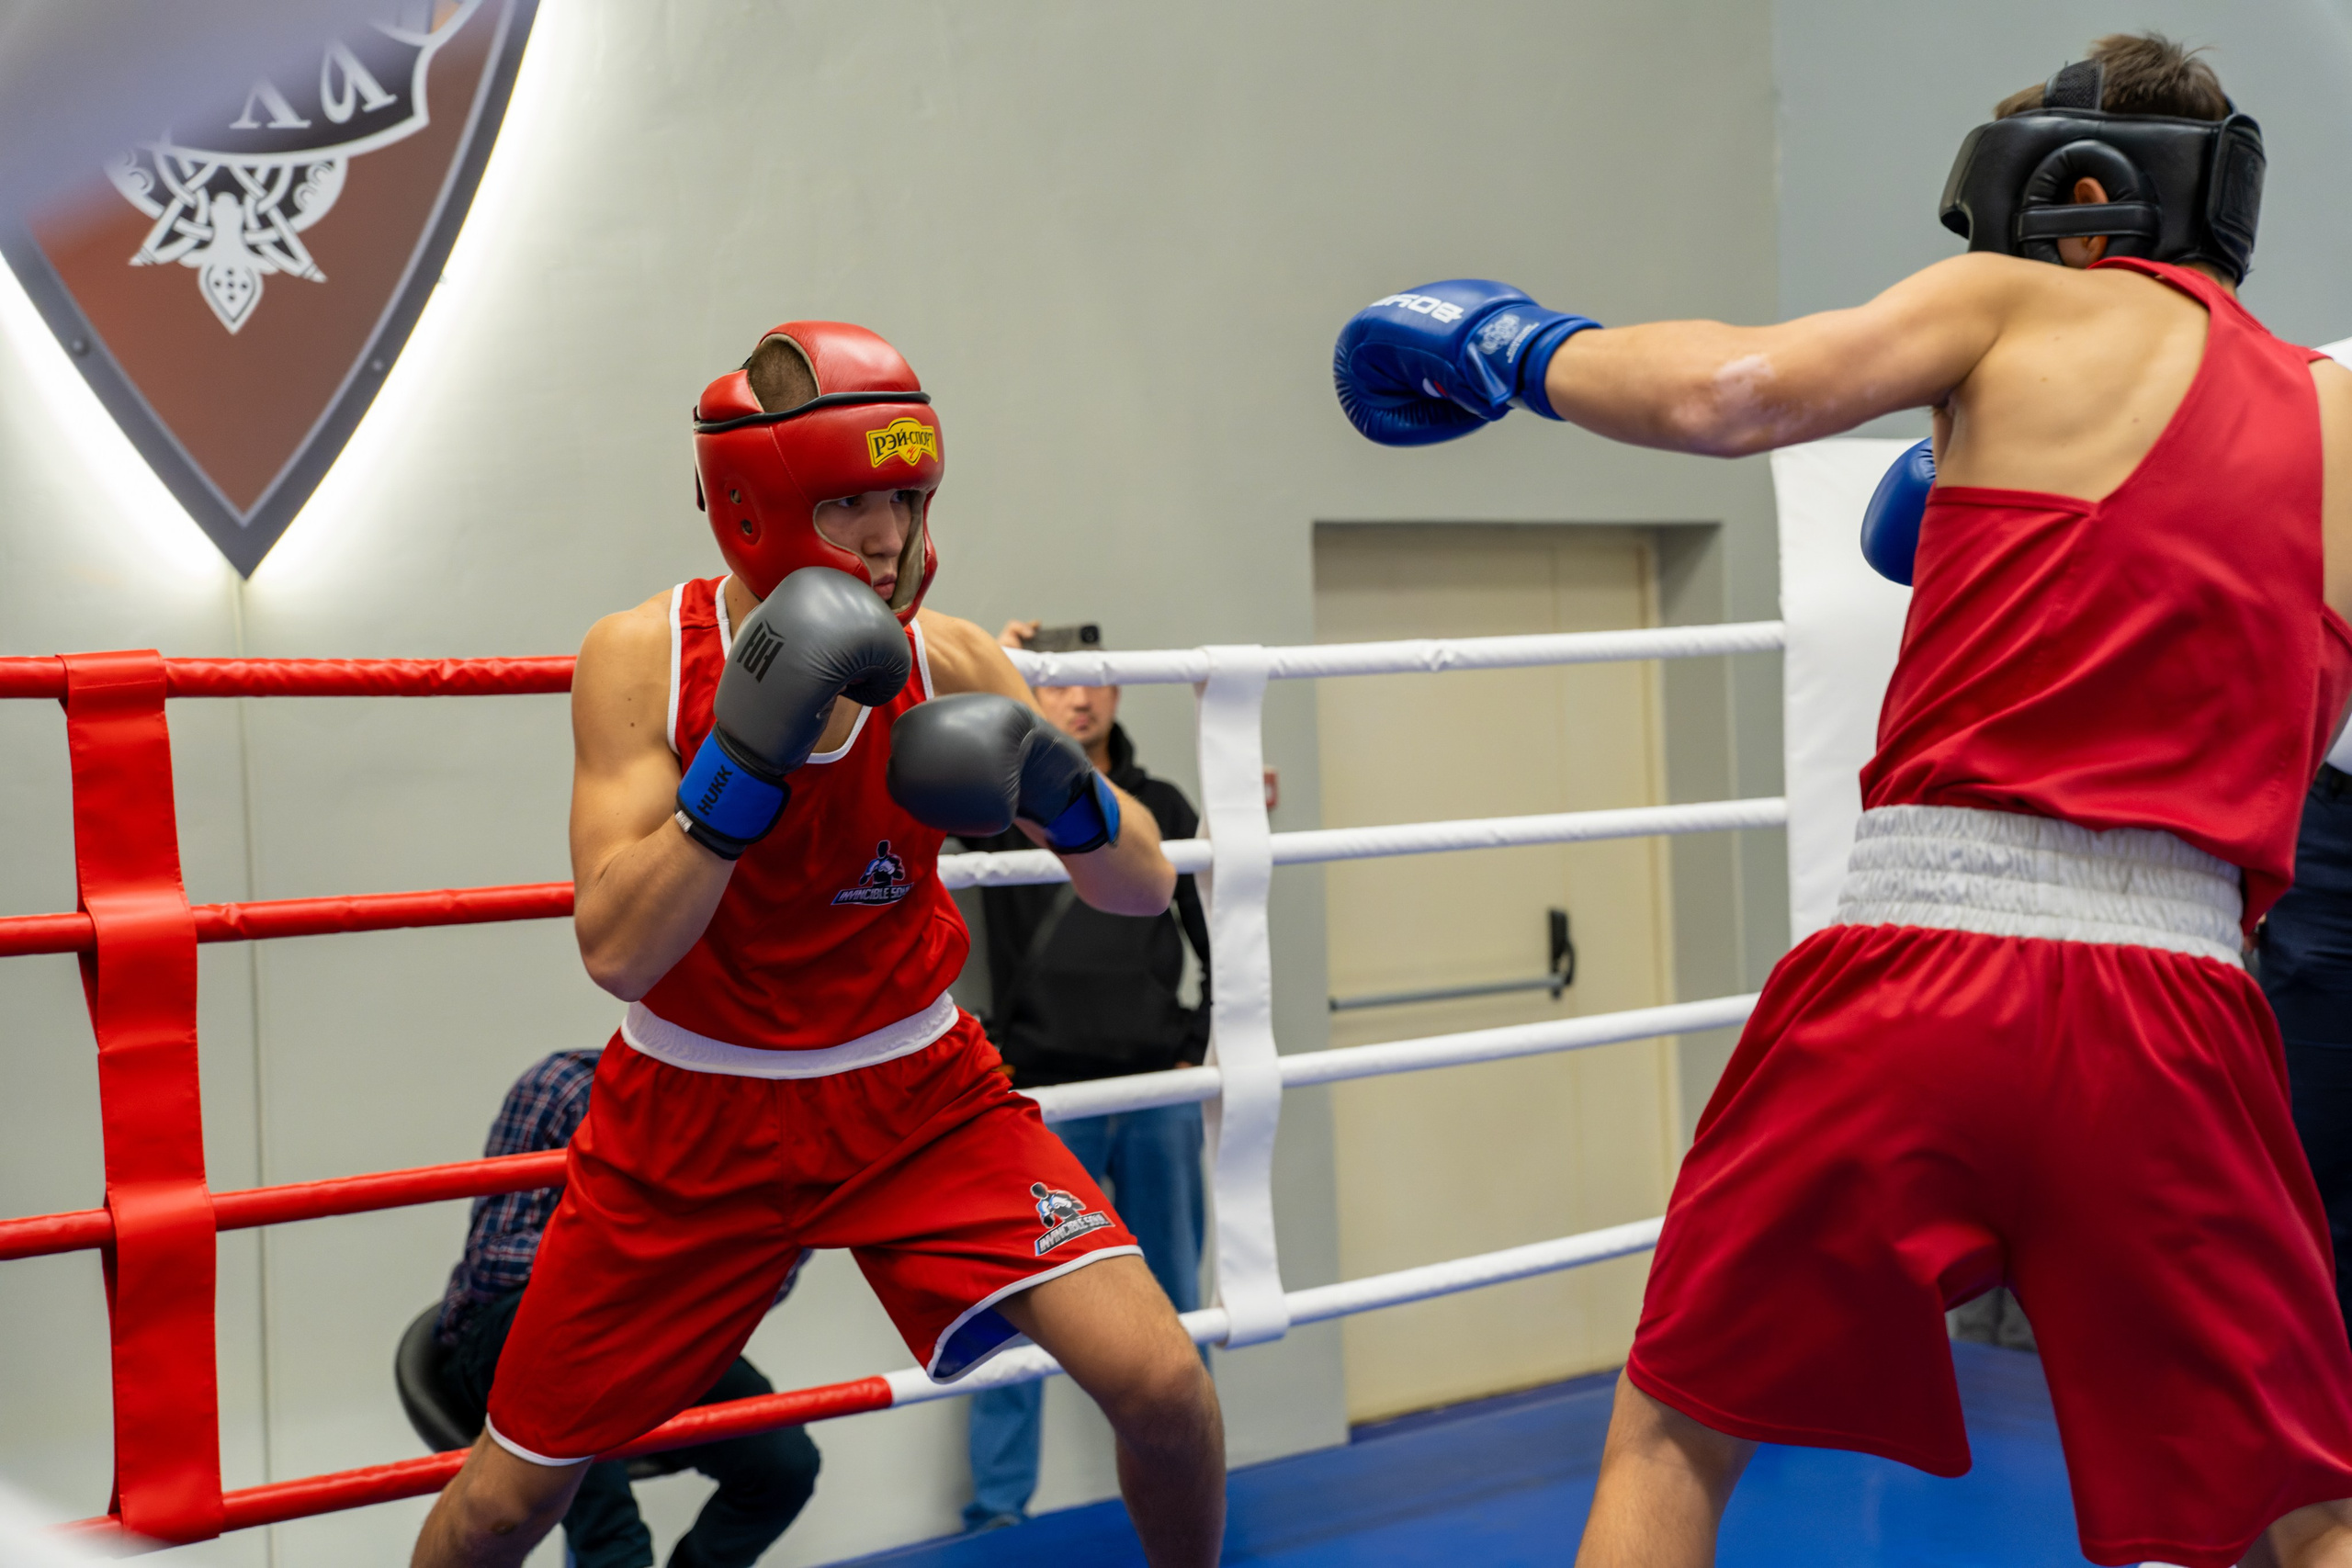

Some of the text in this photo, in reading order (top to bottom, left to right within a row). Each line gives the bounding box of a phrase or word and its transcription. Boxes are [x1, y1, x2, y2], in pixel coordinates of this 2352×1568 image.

[873, 428, 934, 459] РЭЙ-СПОРТ
[696, 764, 733, 816] HUKK
[838, 887, 889, 901] INVINCIBLE
[1039, 1217, 1088, 1252] INVINCIBLE
